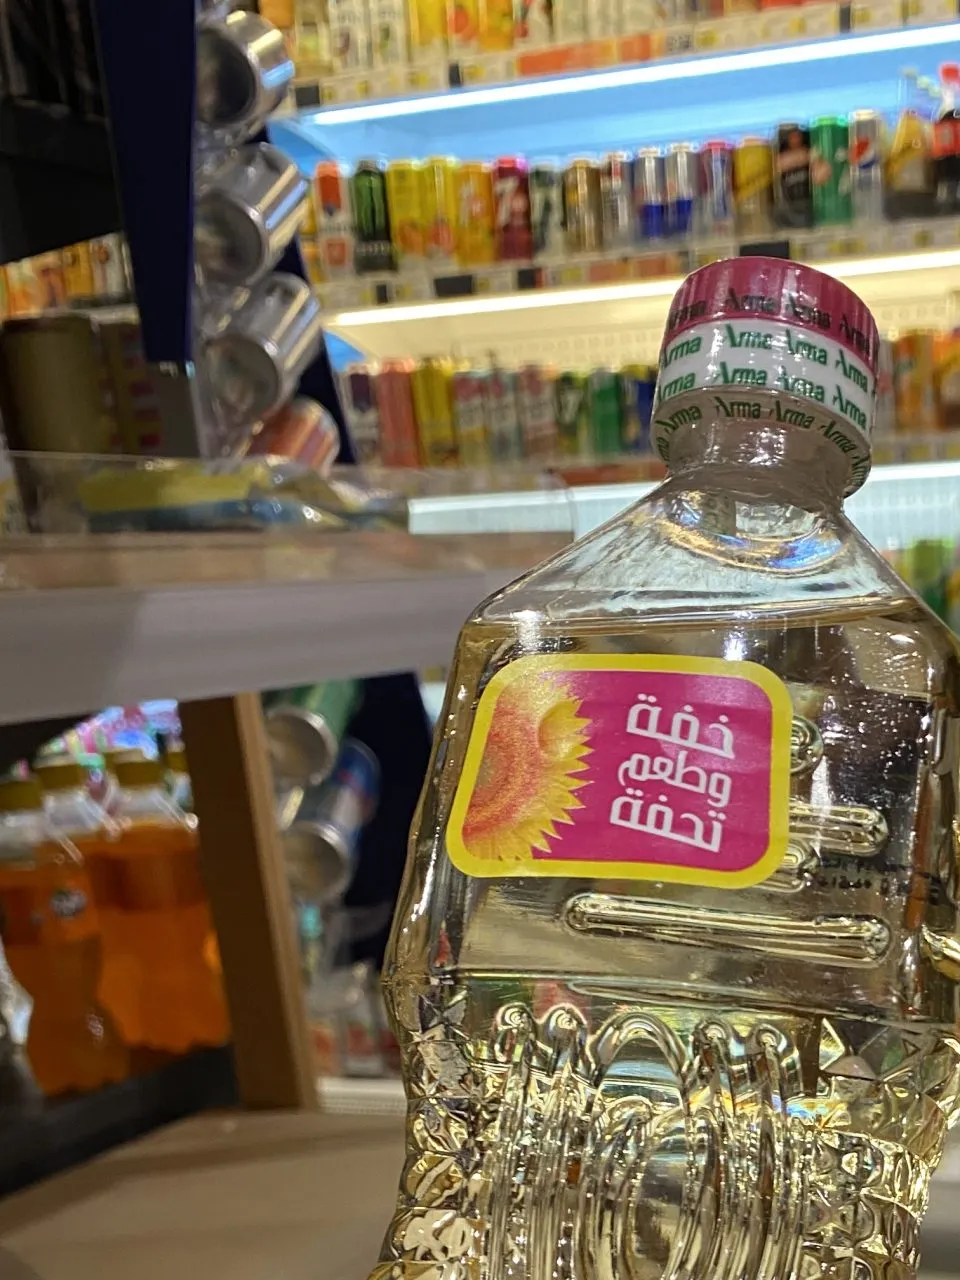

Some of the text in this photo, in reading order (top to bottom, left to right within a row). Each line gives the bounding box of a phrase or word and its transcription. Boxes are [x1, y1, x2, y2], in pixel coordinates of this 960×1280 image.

[725, 324, 774, 350] Arma
[786, 328, 827, 366] Arma
[835, 350, 868, 393] Arma
[656, 405, 702, 435] Arma
[716, 396, 761, 419] Arma
[769, 401, 814, 428] Arma
[820, 421, 858, 454] Arma
[716, 362, 767, 385] Arma
[777, 366, 825, 402] Arma
[833, 385, 866, 430] Arma
[627, 693, 734, 759] خفة
[618, 750, 731, 808] وطعم
[610, 787, 726, 852] تحفة
